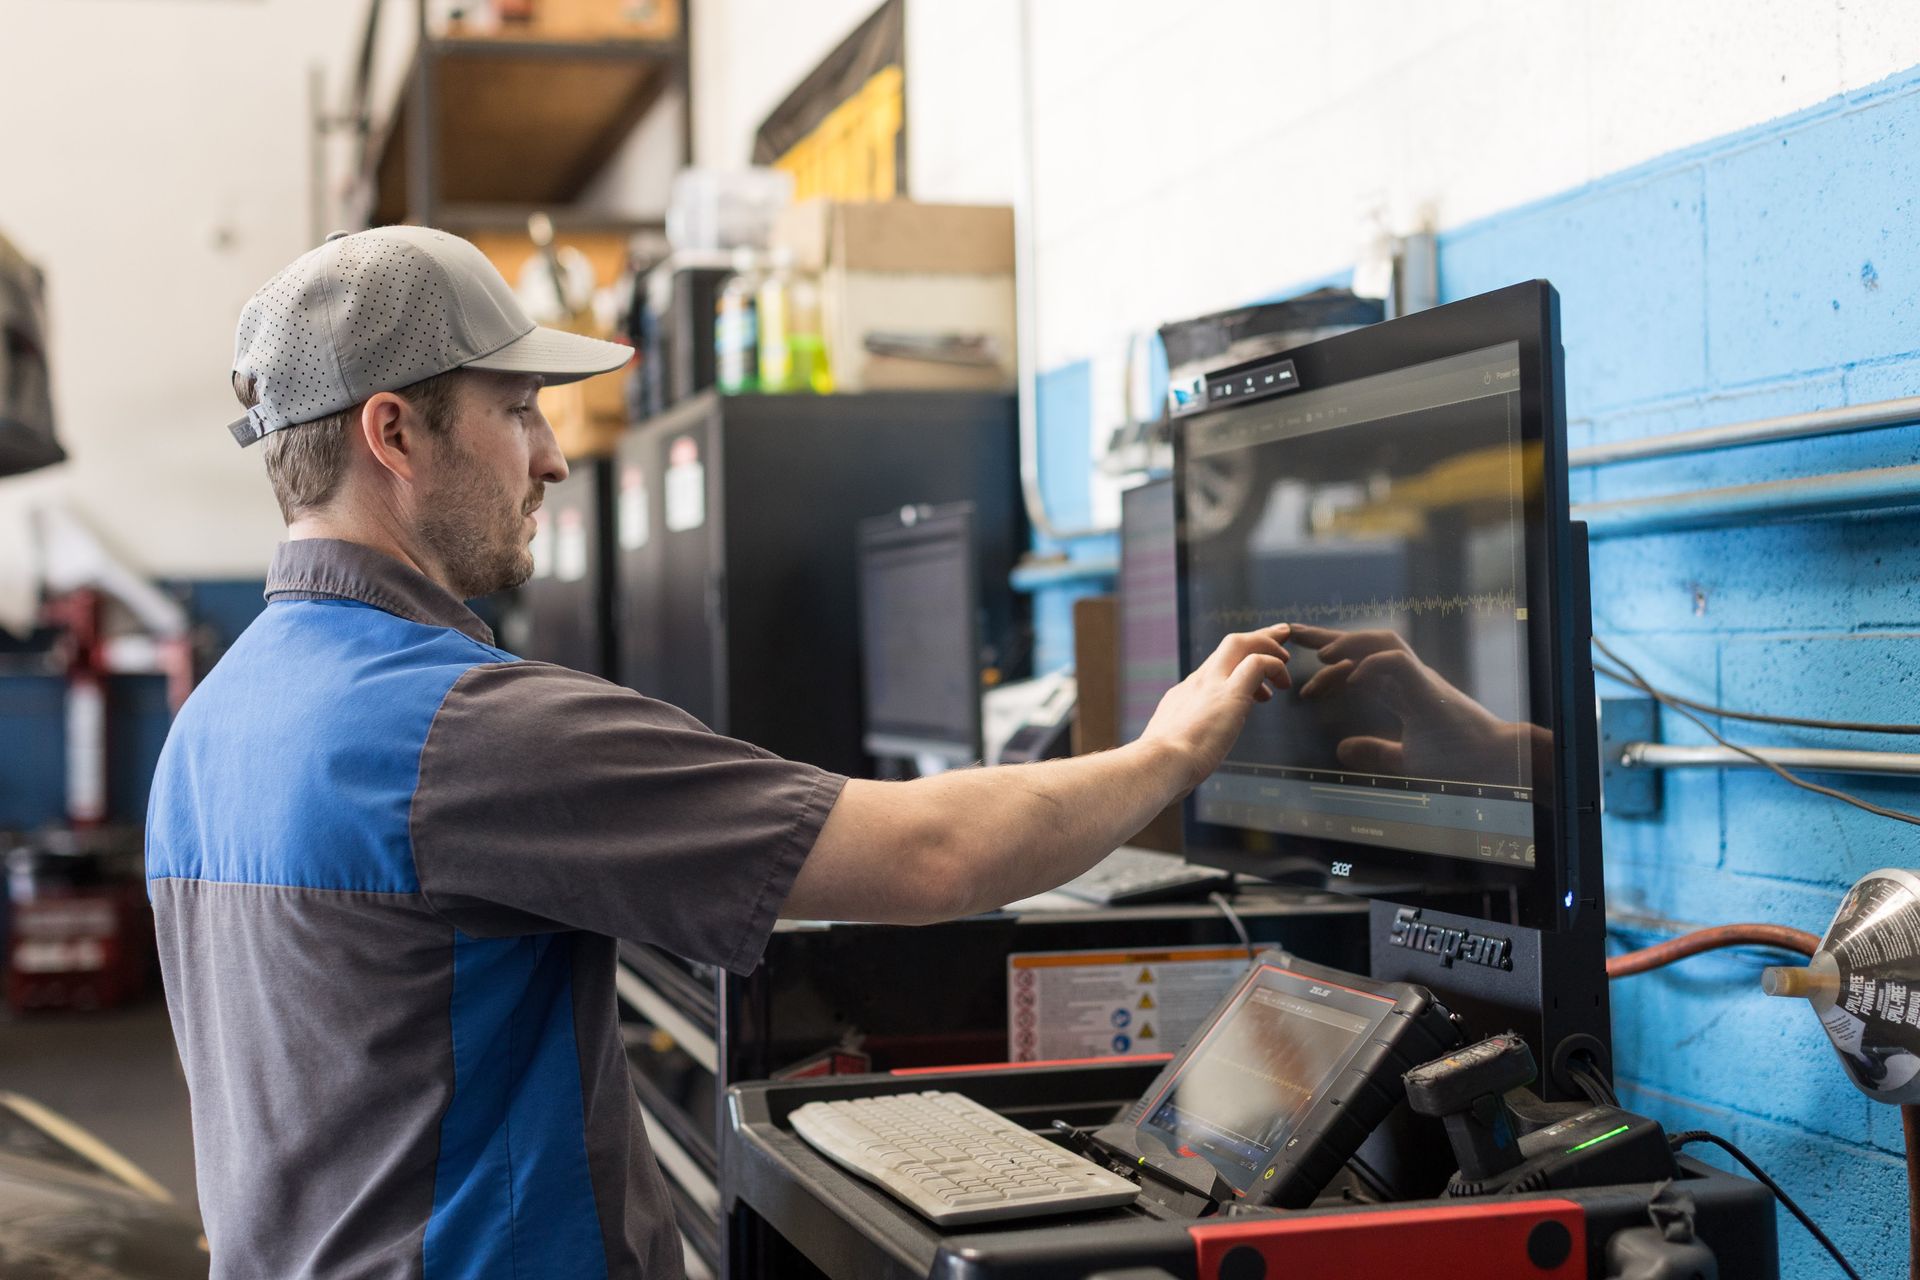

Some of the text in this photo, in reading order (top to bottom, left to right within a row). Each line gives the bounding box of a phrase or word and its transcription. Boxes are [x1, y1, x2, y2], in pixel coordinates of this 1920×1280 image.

[1331, 861, 1352, 876] acer
[1845, 973, 1864, 1014] SPILL-FREE
[1860, 979, 1876, 1016] FUNNEL
[1887, 982, 1907, 1024] SPILL-FREE
[1906, 991, 1920, 1026] EMBUDO
